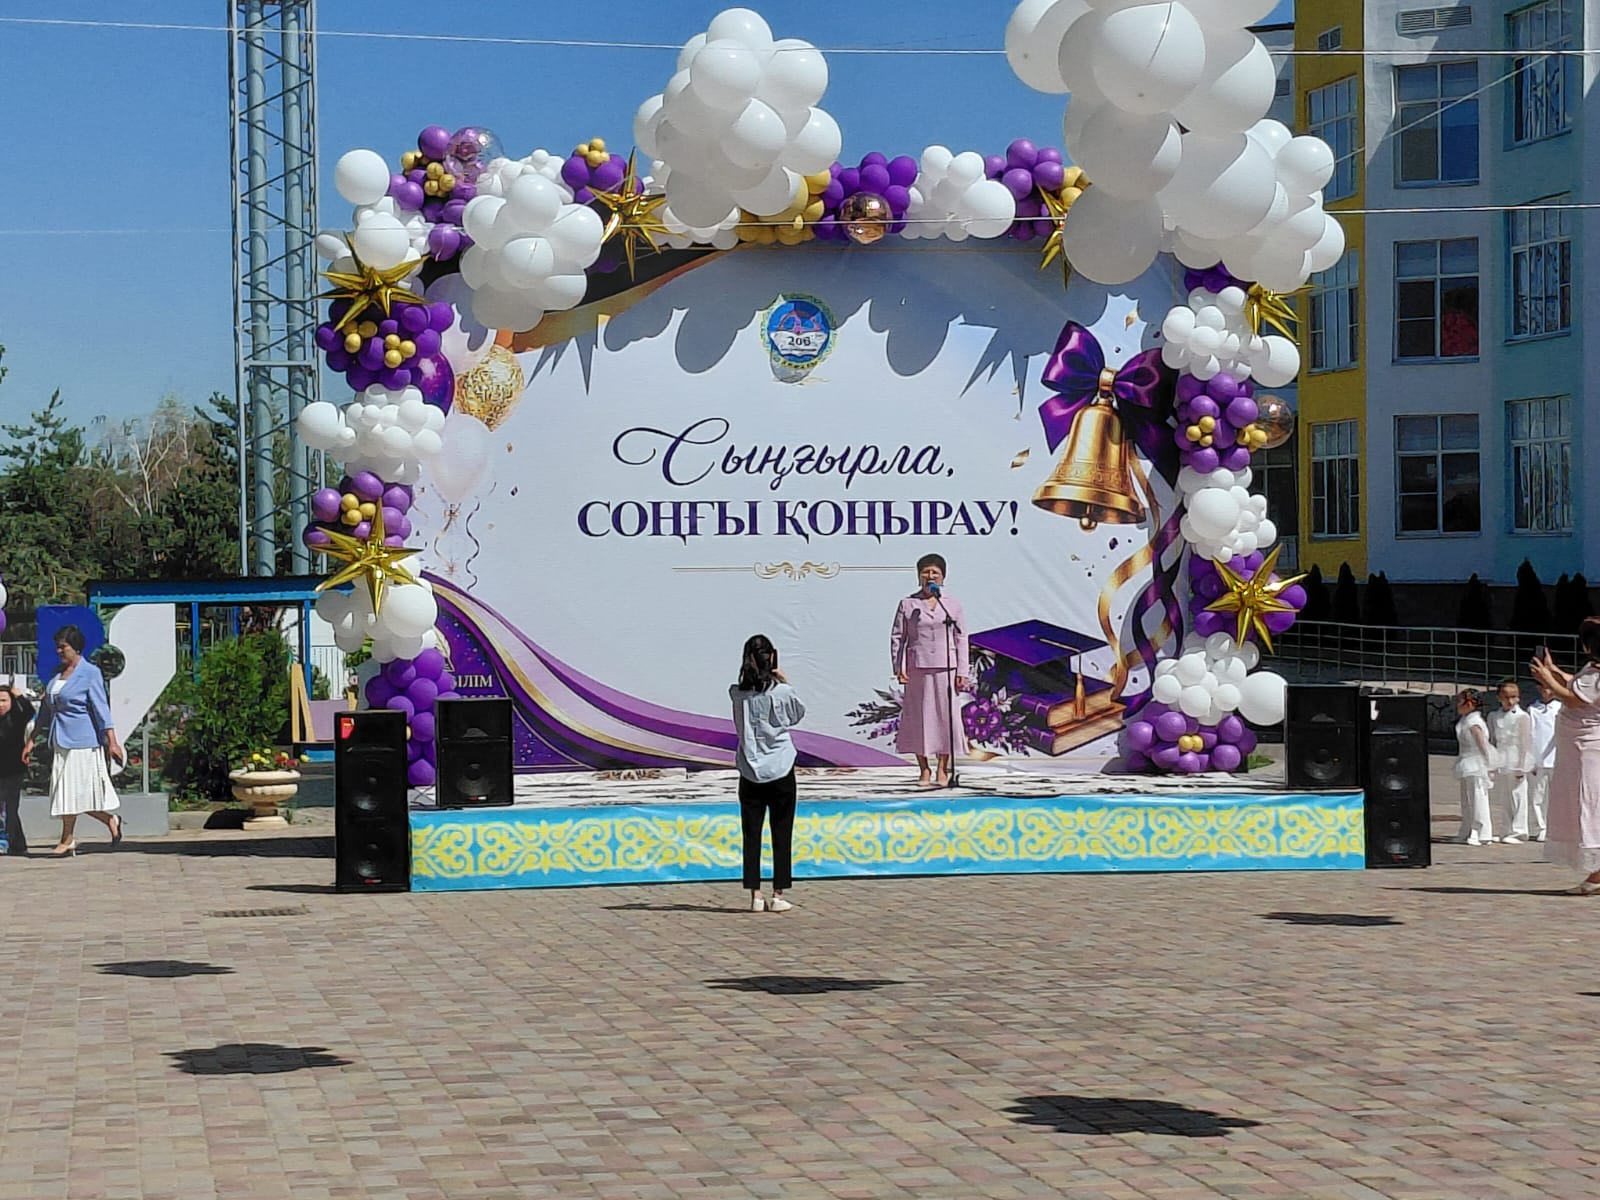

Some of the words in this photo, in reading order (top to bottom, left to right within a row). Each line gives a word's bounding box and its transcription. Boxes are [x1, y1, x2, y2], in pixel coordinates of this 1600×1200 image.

[613, 417, 954, 490] Сыңғырла,
[577, 500, 762, 545] СОҢҒЫ
[775, 500, 1019, 545] ҚОҢЫРАУ!
